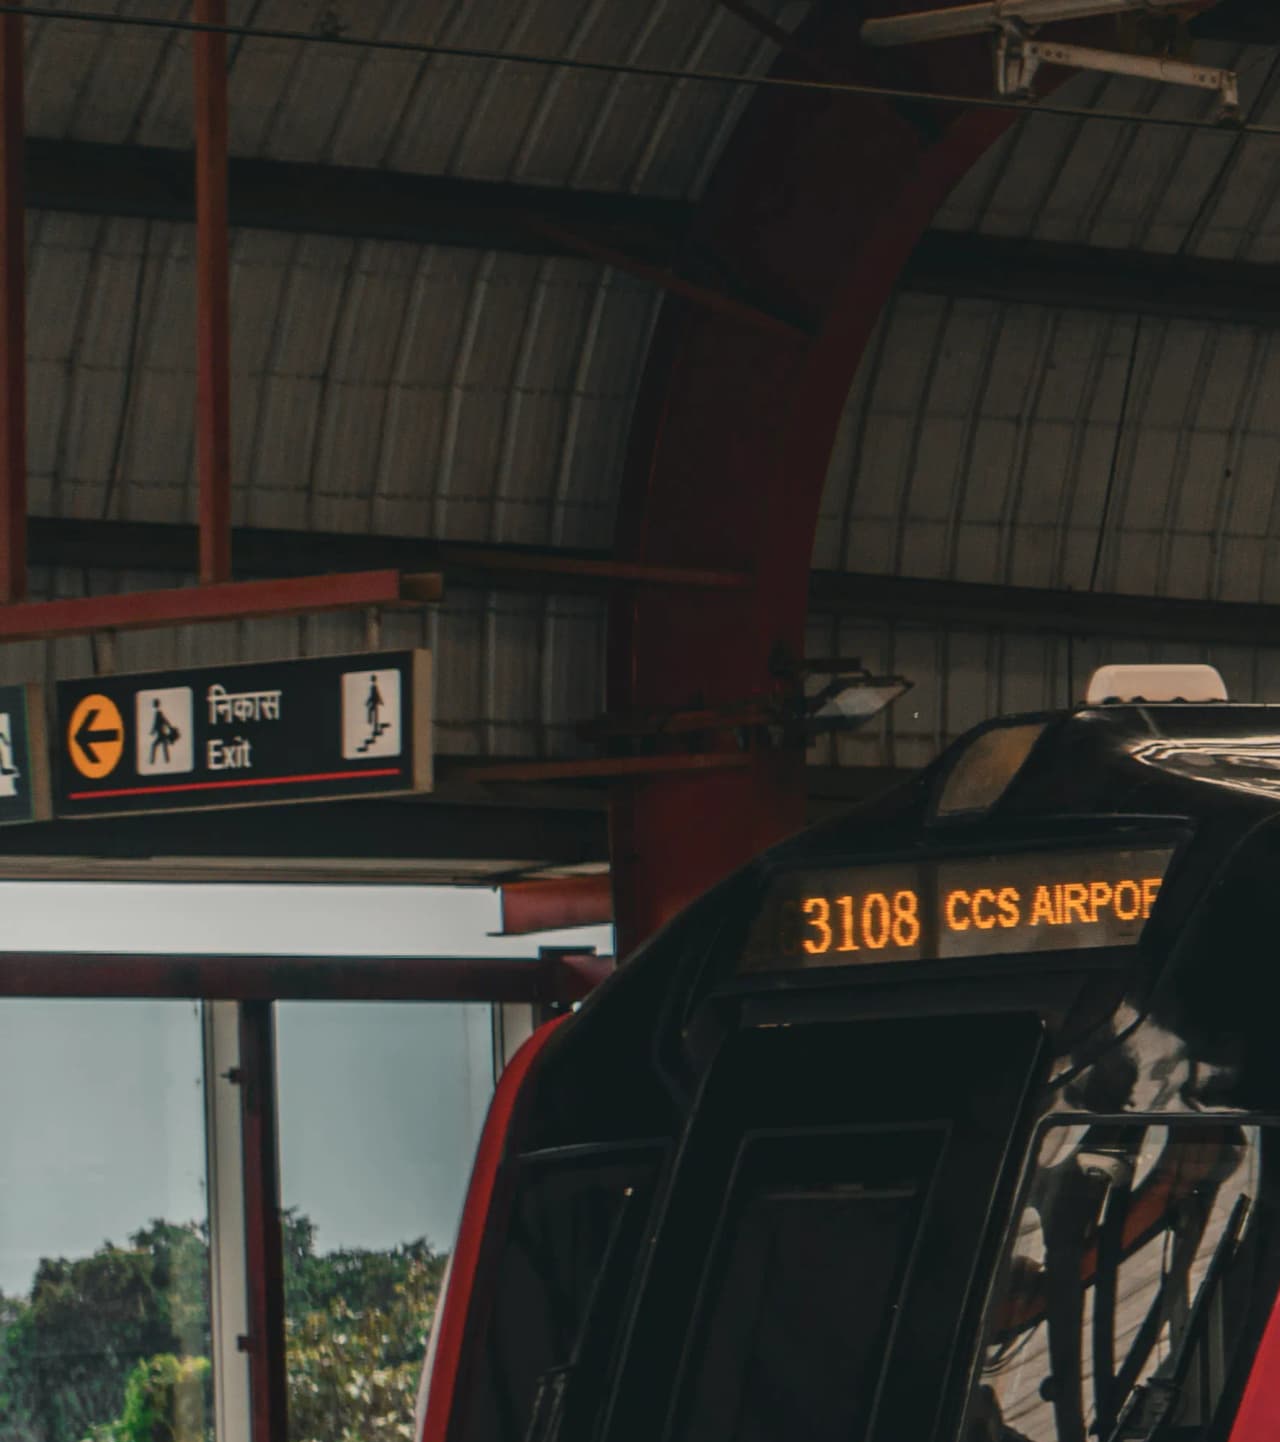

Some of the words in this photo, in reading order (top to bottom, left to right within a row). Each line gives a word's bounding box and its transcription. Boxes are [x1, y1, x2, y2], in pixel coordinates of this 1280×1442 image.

[207, 684, 282, 724] निकास
[207, 736, 252, 769] Exit
[803, 891, 921, 954] 3108
[945, 886, 1020, 931] CCS
